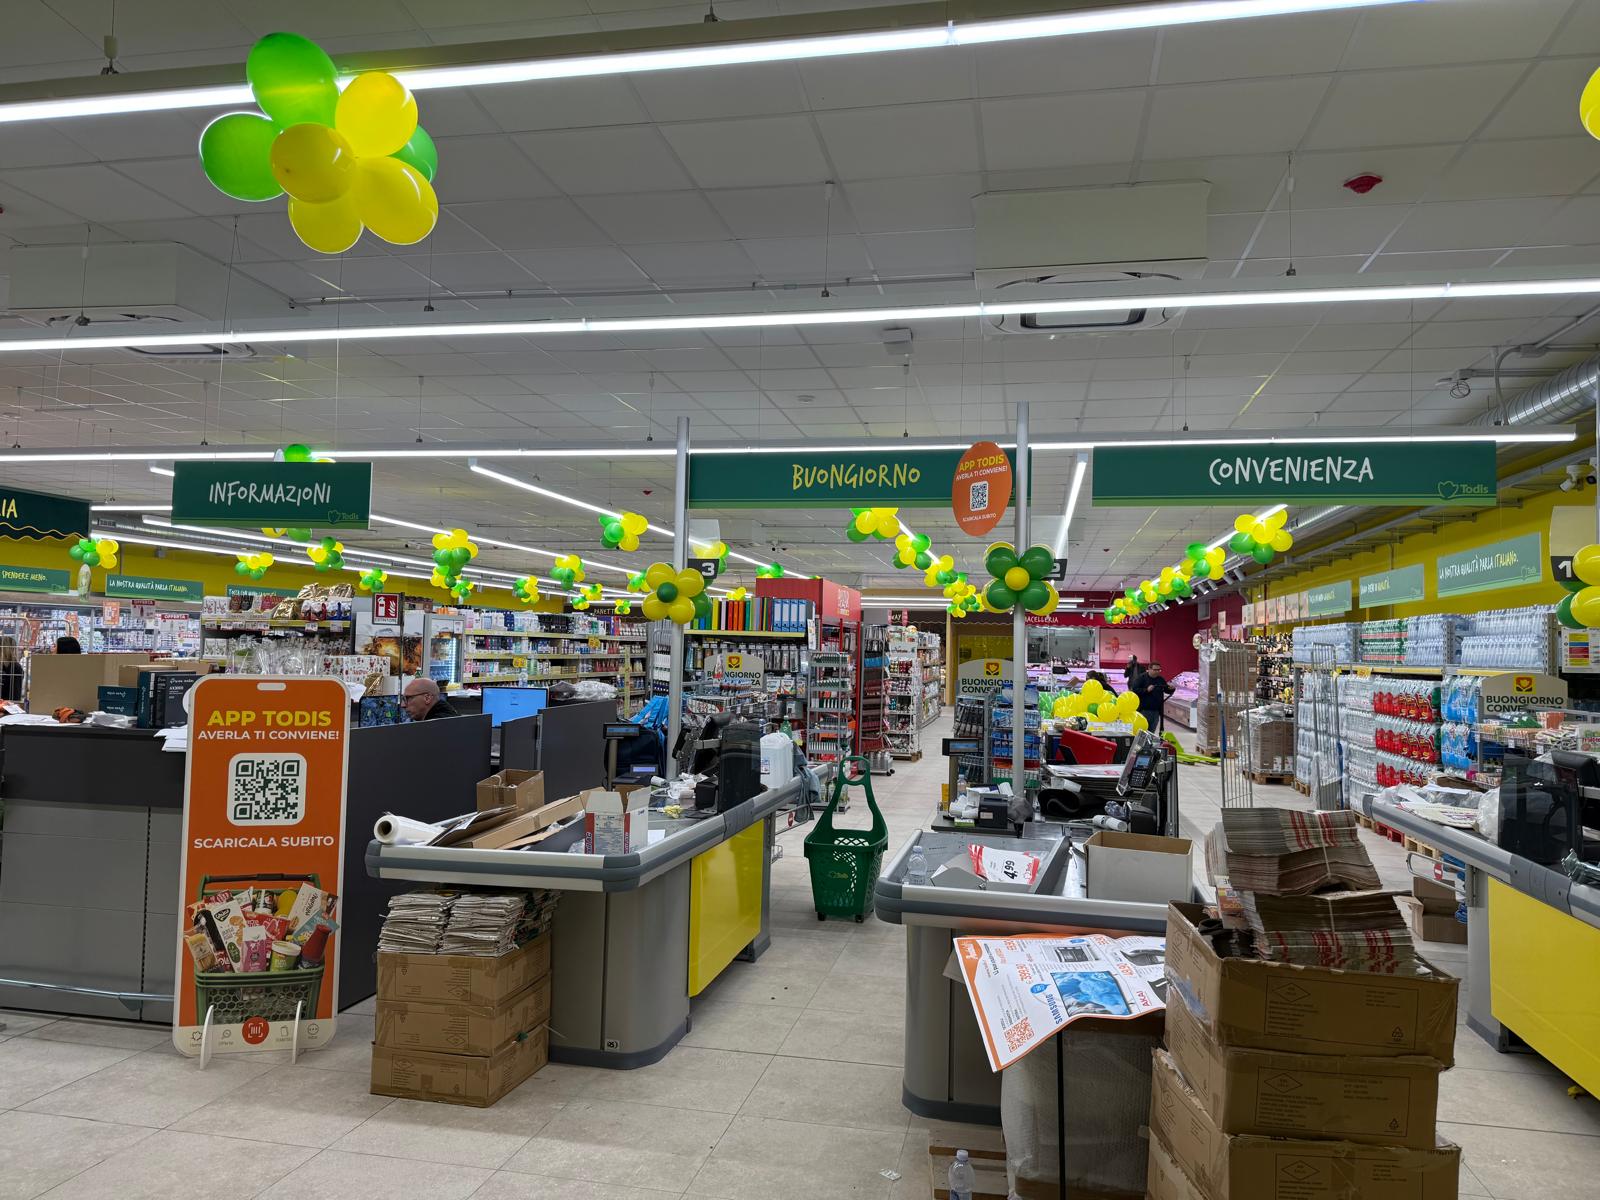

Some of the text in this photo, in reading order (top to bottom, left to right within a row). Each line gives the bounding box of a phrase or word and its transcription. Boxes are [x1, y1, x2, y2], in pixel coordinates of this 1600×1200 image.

[959, 454, 1005, 472] APP TODIS
[1209, 456, 1374, 486] CONVENIENZA
[792, 463, 920, 490] BUONGIORNO
[209, 481, 331, 507] INFORMAZIONI
[1460, 483, 1489, 495] Todis
[2, 571, 29, 580] SPENDERE
[702, 562, 714, 577] 3
[1557, 560, 1572, 578] 1
[707, 671, 761, 679] BNGIORNO
[961, 679, 1014, 687] BUONGIORN
[1486, 695, 1565, 705] BUONGIORNO
[207, 710, 332, 727] APP TODIS
[198, 730, 339, 740] AVERLA TI CONVIENE!
[194, 835, 335, 849] SCARICALA SUBITO
[1136, 990, 1151, 1007] AKAI
[1046, 993, 1063, 1025] SAMSUNG
